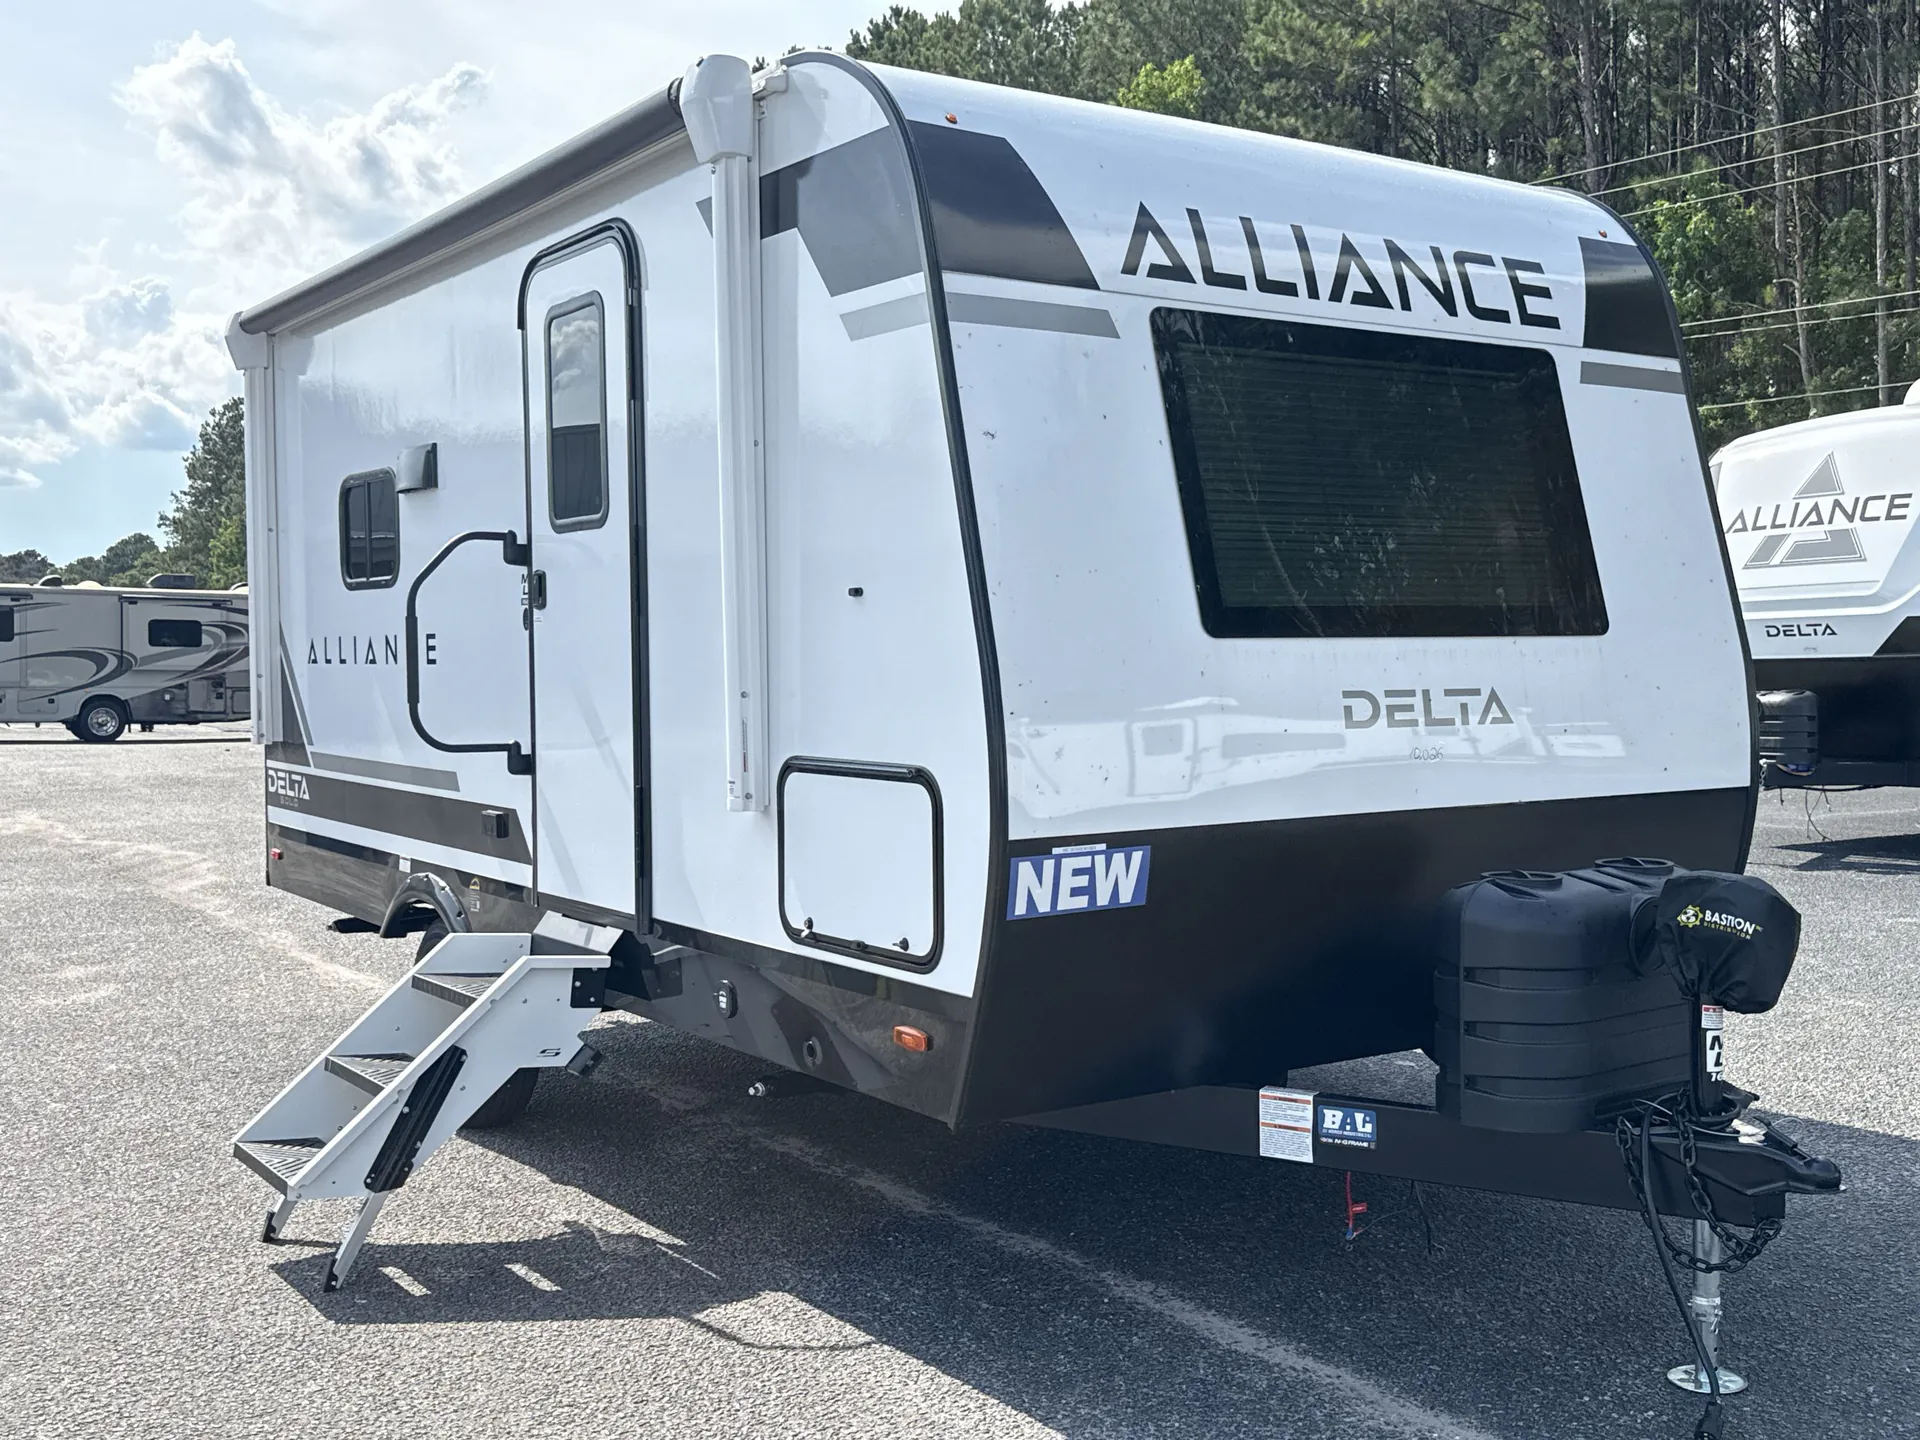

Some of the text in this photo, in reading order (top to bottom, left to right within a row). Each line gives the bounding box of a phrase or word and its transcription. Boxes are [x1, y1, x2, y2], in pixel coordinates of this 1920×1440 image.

[1120, 201, 1562, 330] ALLIANCE
[1725, 493, 1913, 534] ALLIANCE
[1764, 623, 1838, 638] DELTA
[308, 633, 437, 665] ALLIANE
[1341, 686, 1515, 730] DELTA
[268, 769, 310, 801] DELTA
[1014, 850, 1144, 916] NEW
[1704, 909, 1756, 935] BASTION
[1322, 1108, 1373, 1133] BAL
